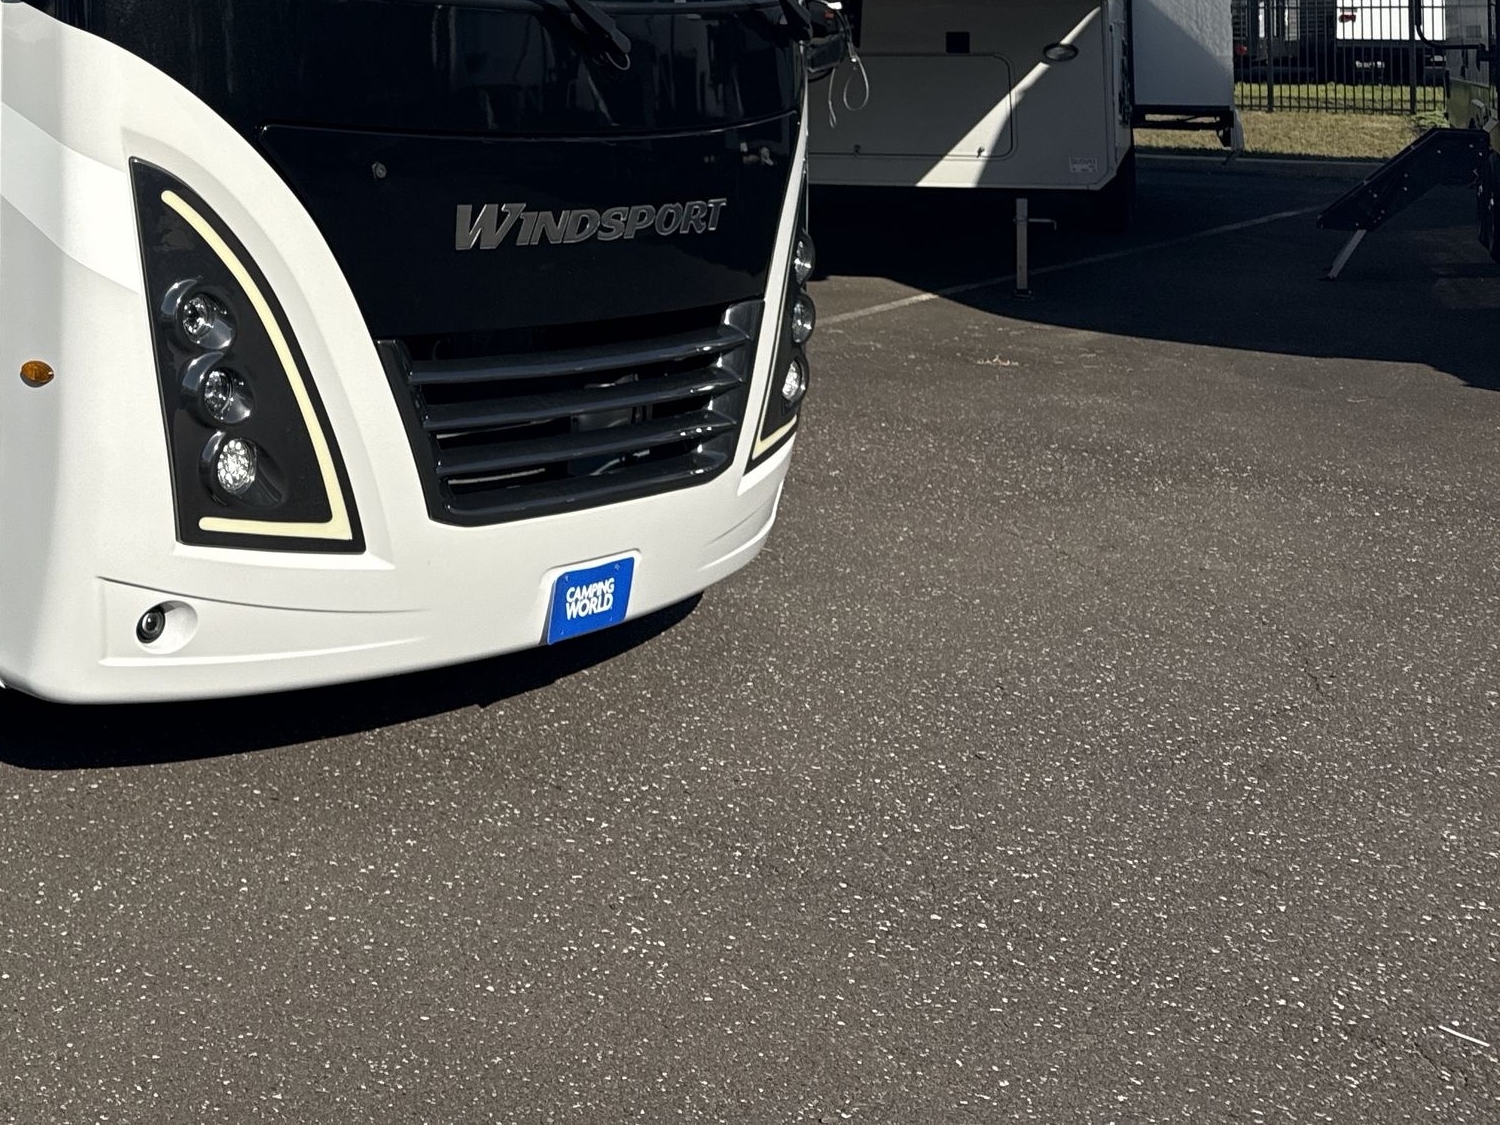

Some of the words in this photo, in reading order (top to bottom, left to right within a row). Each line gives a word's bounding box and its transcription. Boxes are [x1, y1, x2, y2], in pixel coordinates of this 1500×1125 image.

[455, 197, 727, 250] WINDSPORT
[566, 577, 615, 603] CAMPING
[565, 593, 614, 621] WORLD
